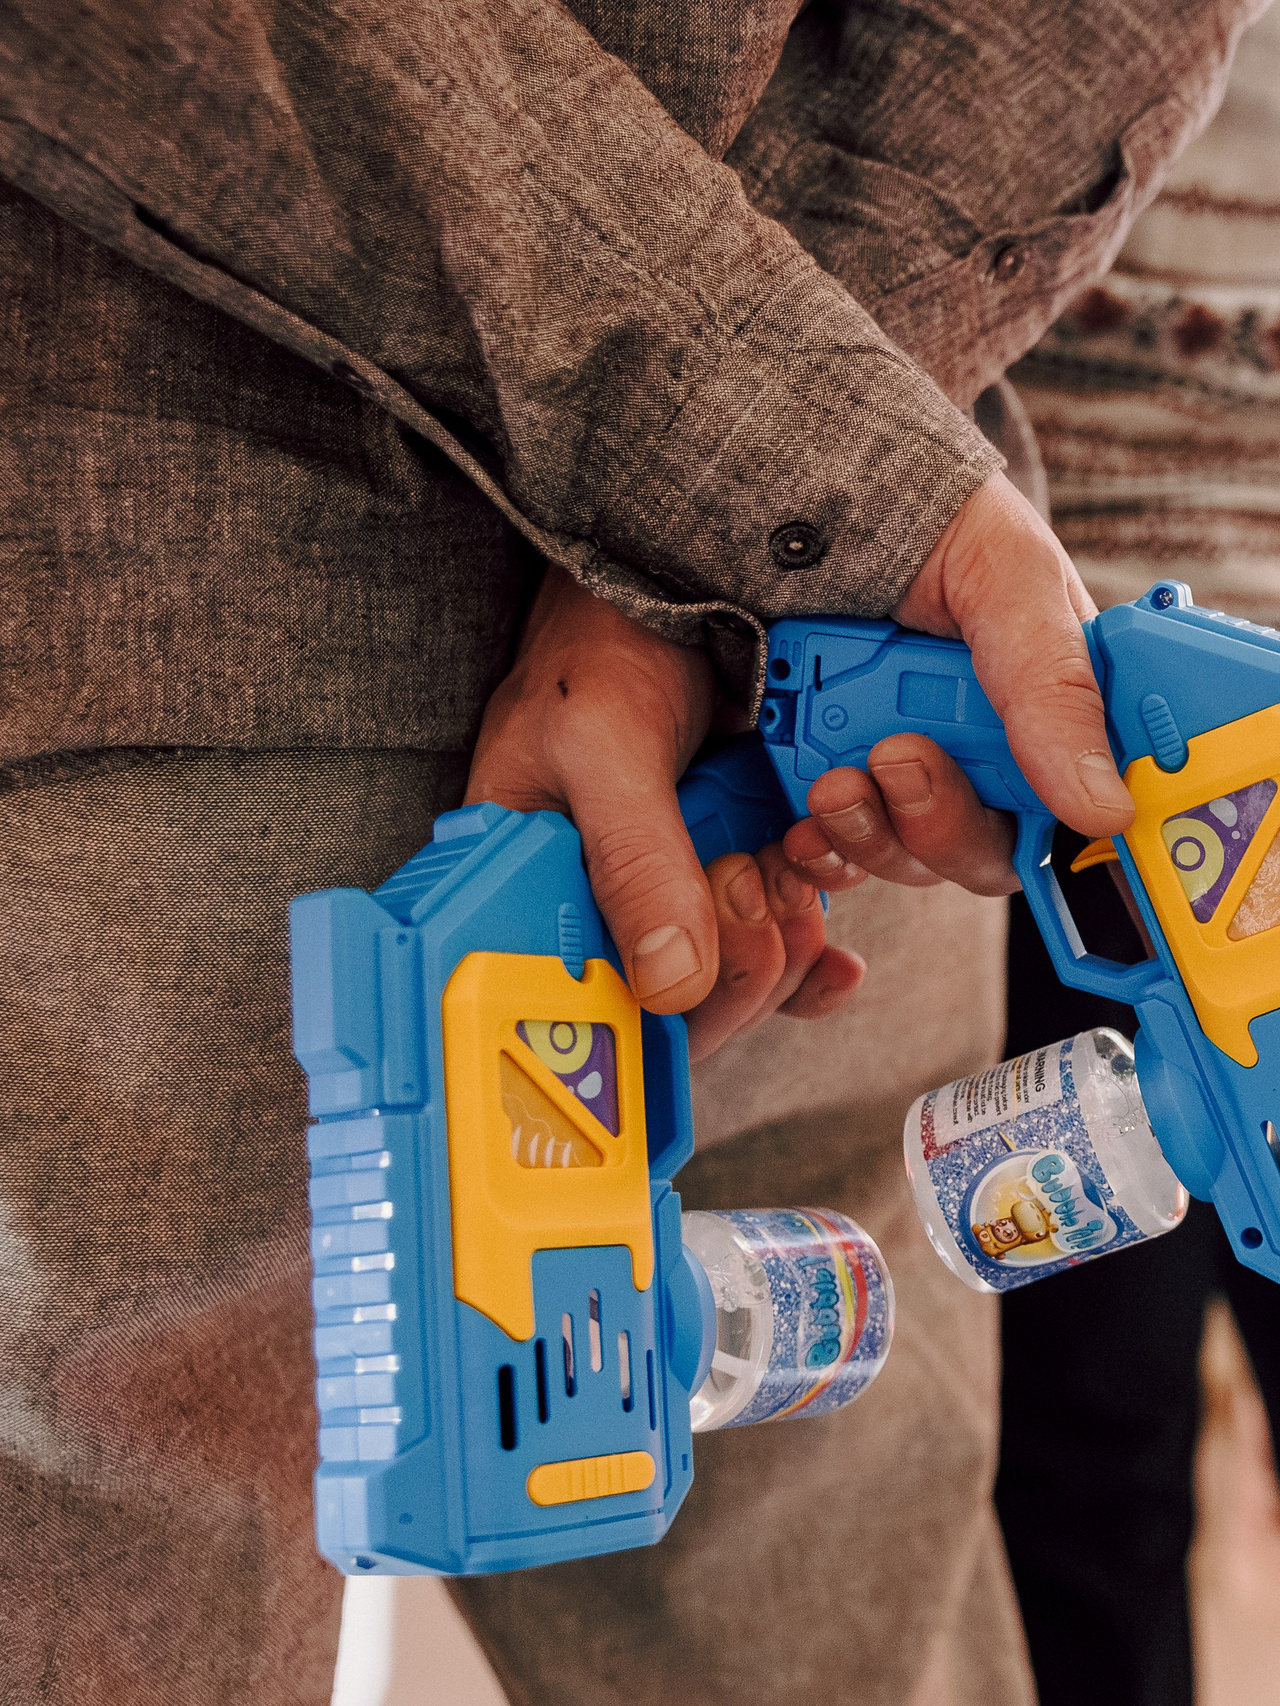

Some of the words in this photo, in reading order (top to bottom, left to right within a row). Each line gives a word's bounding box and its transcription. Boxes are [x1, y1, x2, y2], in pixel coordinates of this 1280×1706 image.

[1034, 1051, 1046, 1092] WARNING
[1032, 1154, 1083, 1227] Bubble
[805, 1268, 841, 1371] Bubble
